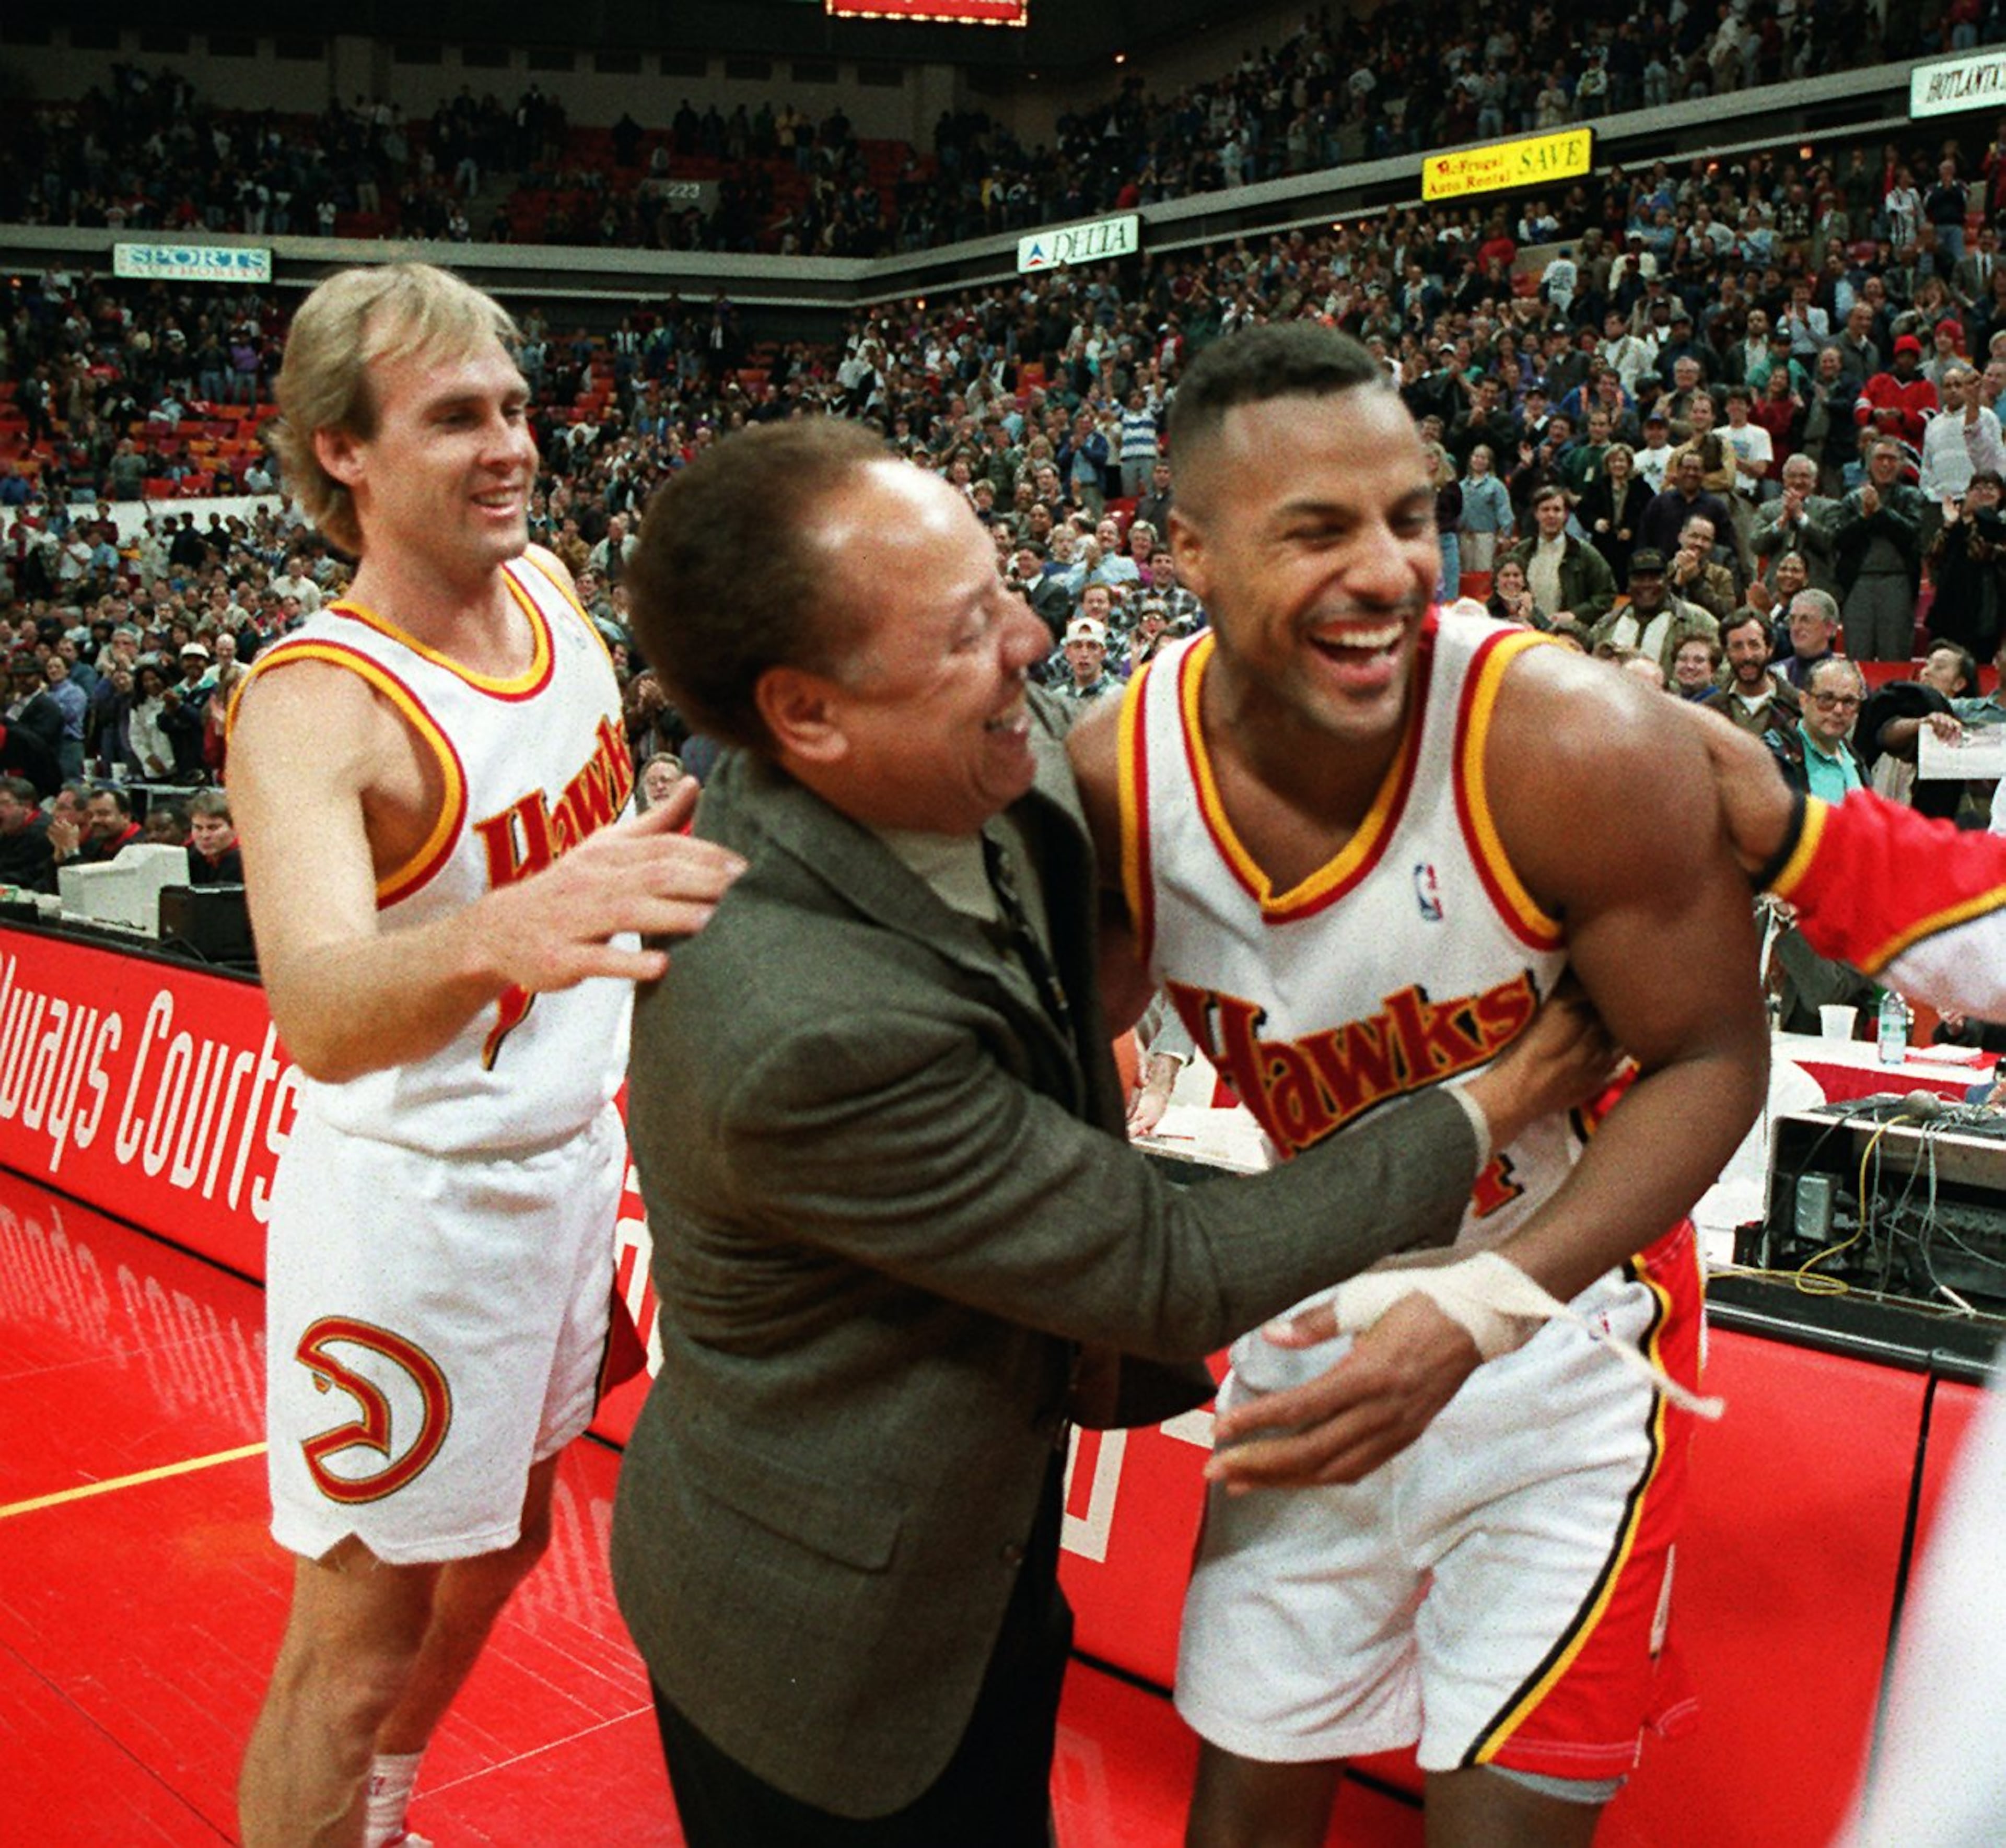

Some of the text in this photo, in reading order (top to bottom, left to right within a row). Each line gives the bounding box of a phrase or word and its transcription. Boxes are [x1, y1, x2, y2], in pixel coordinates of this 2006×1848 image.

[1437, 156, 1503, 176] McFrugal
[1518, 139, 1582, 175] SAVE
[667, 183, 700, 198] 223
[1429, 170, 1510, 195] Auto Rental
[131, 246, 267, 268] SPORTS
[1053, 223, 1126, 262] DELTA
[0, 951, 123, 1173] lways
[1165, 968, 1541, 1162] Hawks
